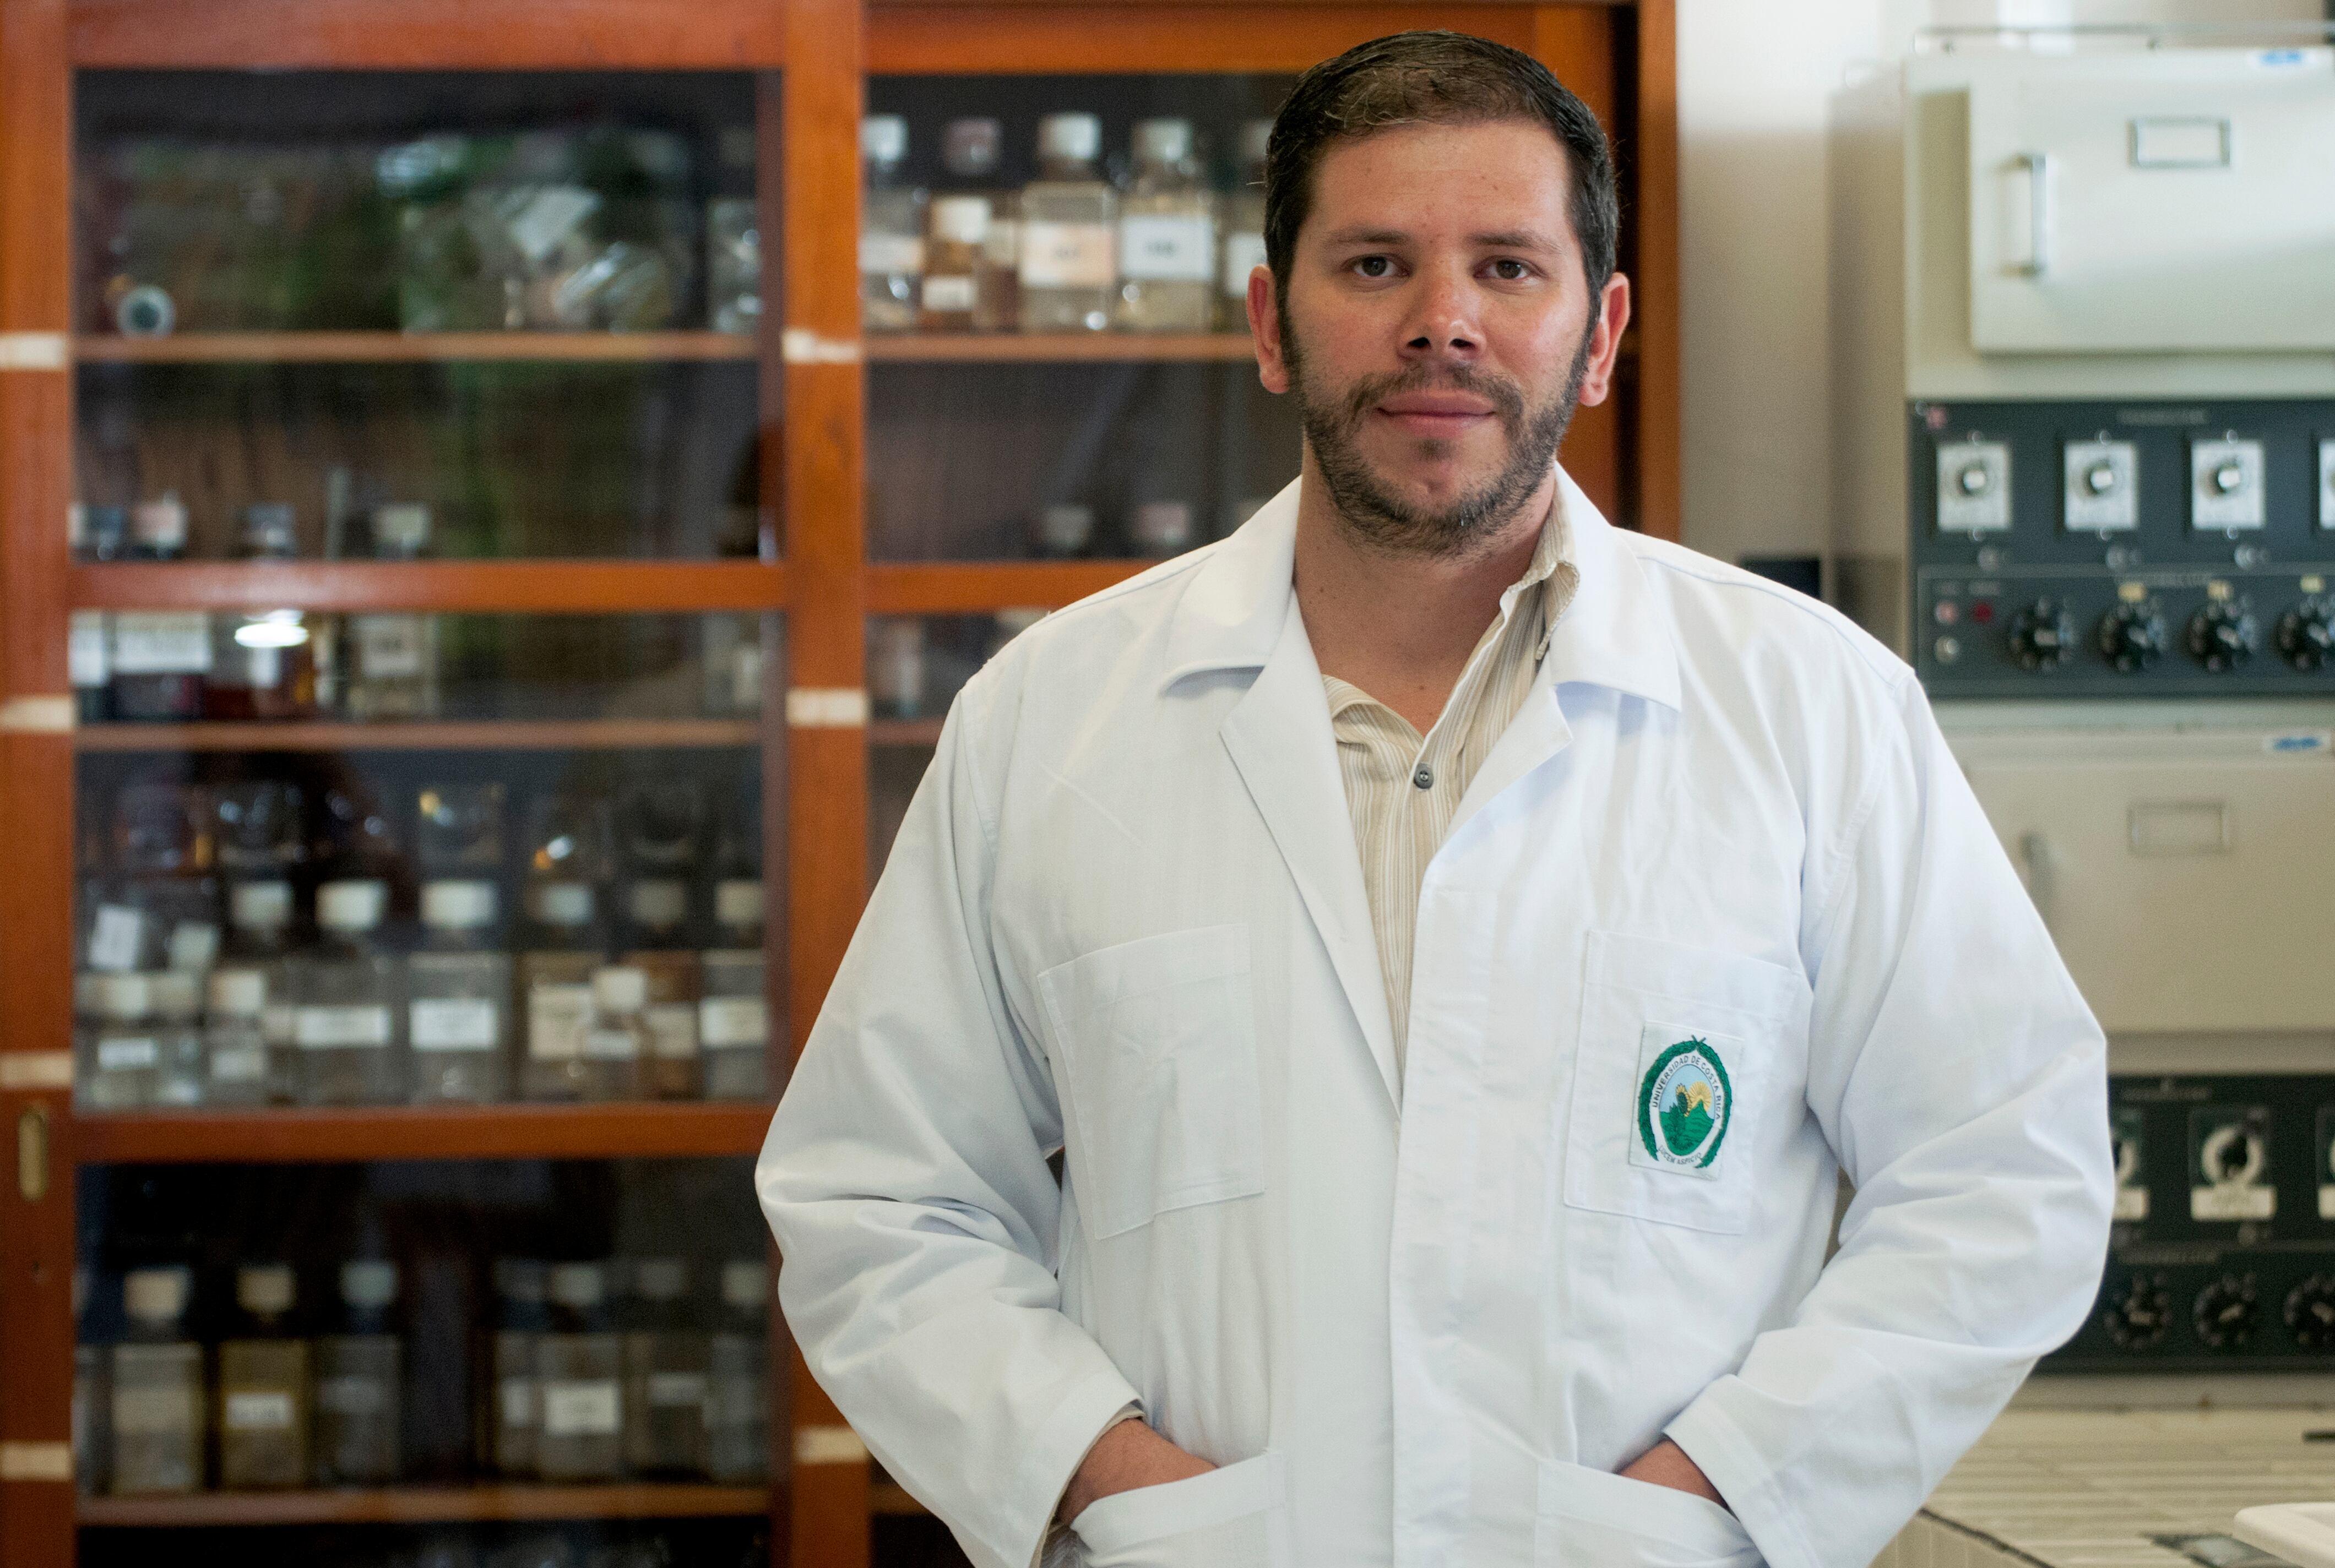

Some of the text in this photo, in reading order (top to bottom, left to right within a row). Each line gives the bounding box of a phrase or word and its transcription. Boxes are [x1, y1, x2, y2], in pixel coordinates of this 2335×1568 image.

[1652, 1055, 1688, 1108] UNIVERSIDAD
[1691, 1055, 1700, 1065] DE
[1701, 1063, 1719, 1092] COSTA
